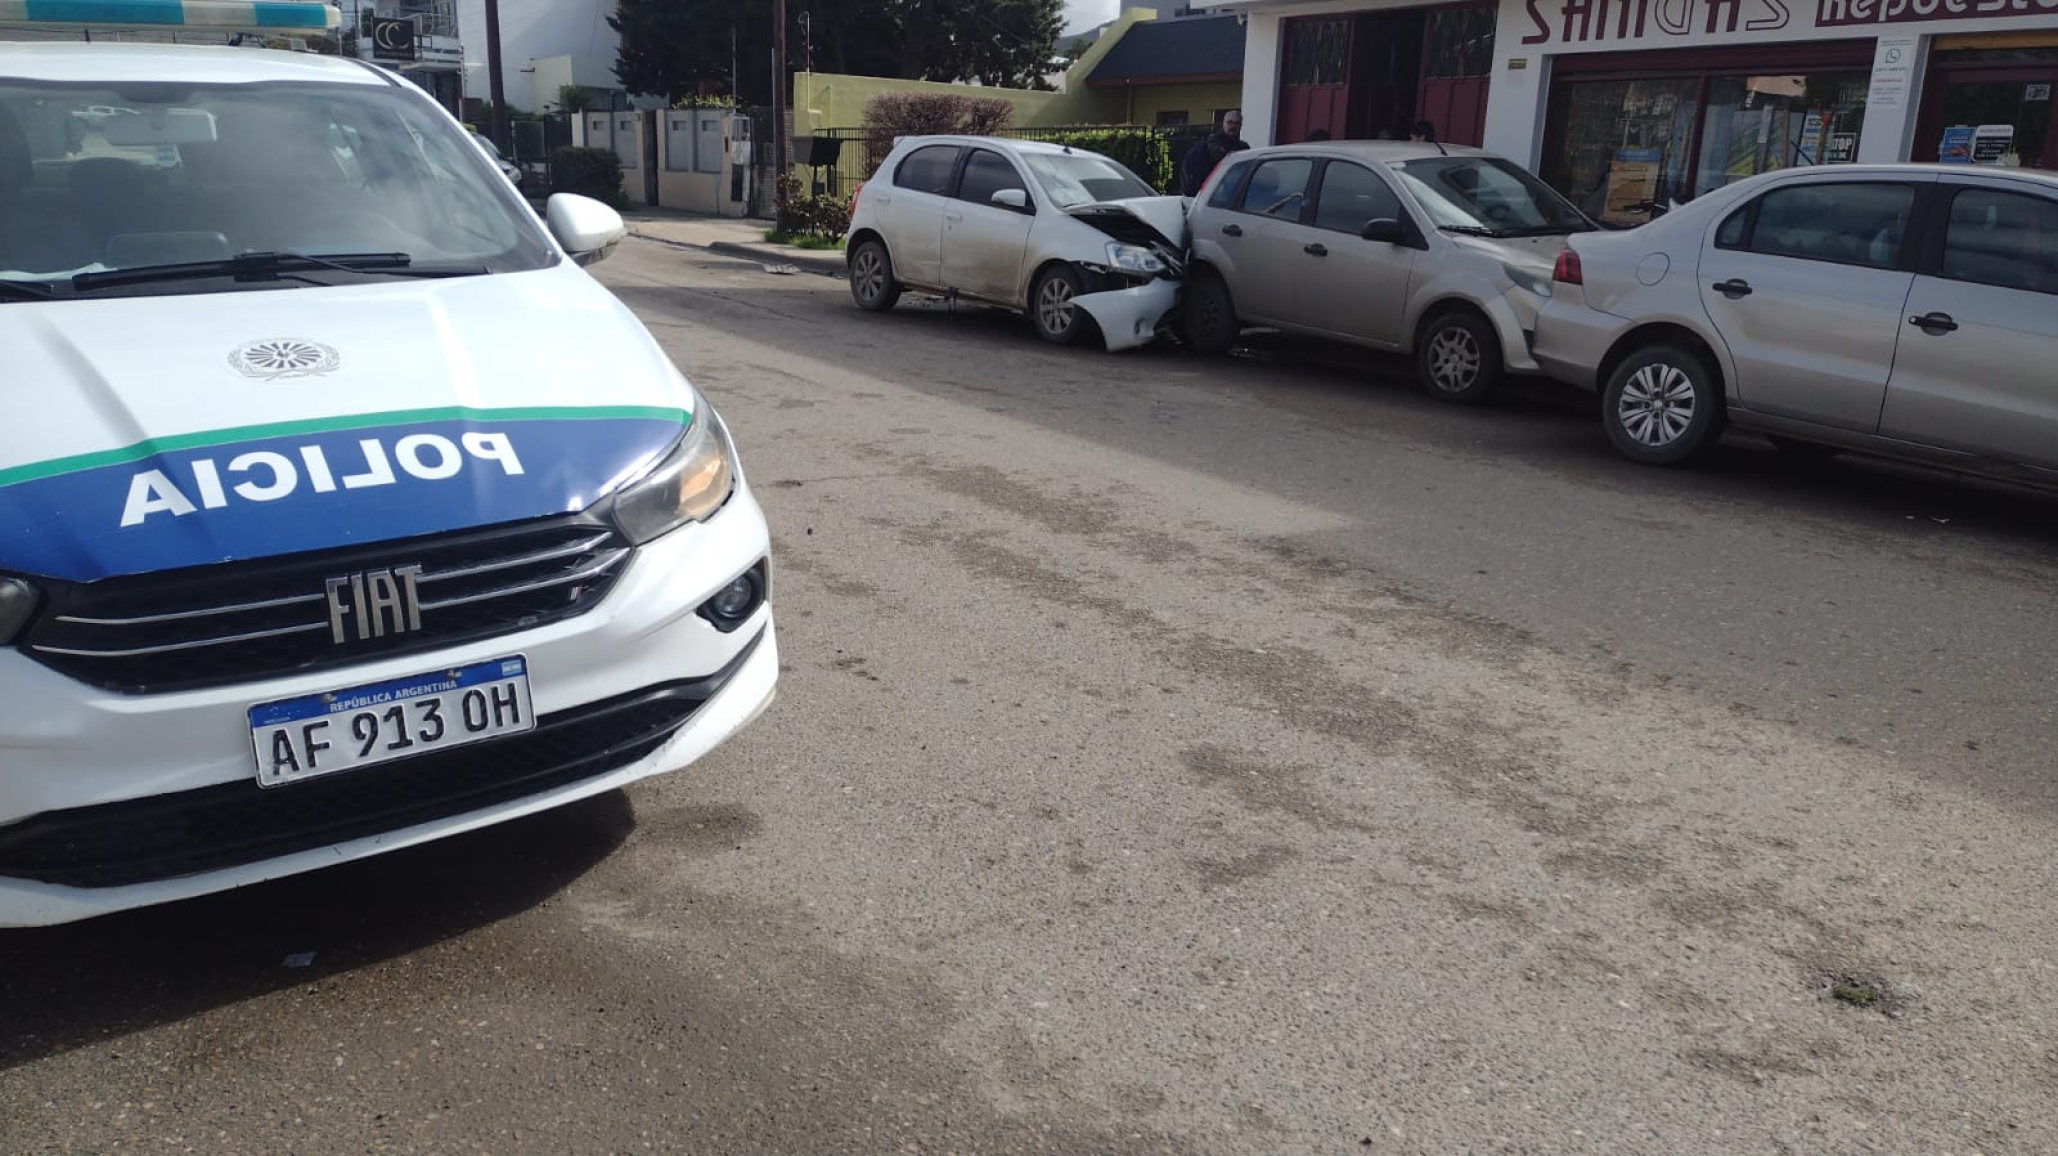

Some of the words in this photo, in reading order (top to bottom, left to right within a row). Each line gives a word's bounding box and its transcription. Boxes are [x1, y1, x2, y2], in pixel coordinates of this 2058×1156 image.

[325, 563, 422, 645] FIAT
[271, 720, 331, 777] AF
[352, 697, 445, 758] 913
[462, 681, 521, 734] OH
[329, 692, 392, 714] REPÚBLICA
[395, 679, 458, 700] ARGENTINA
